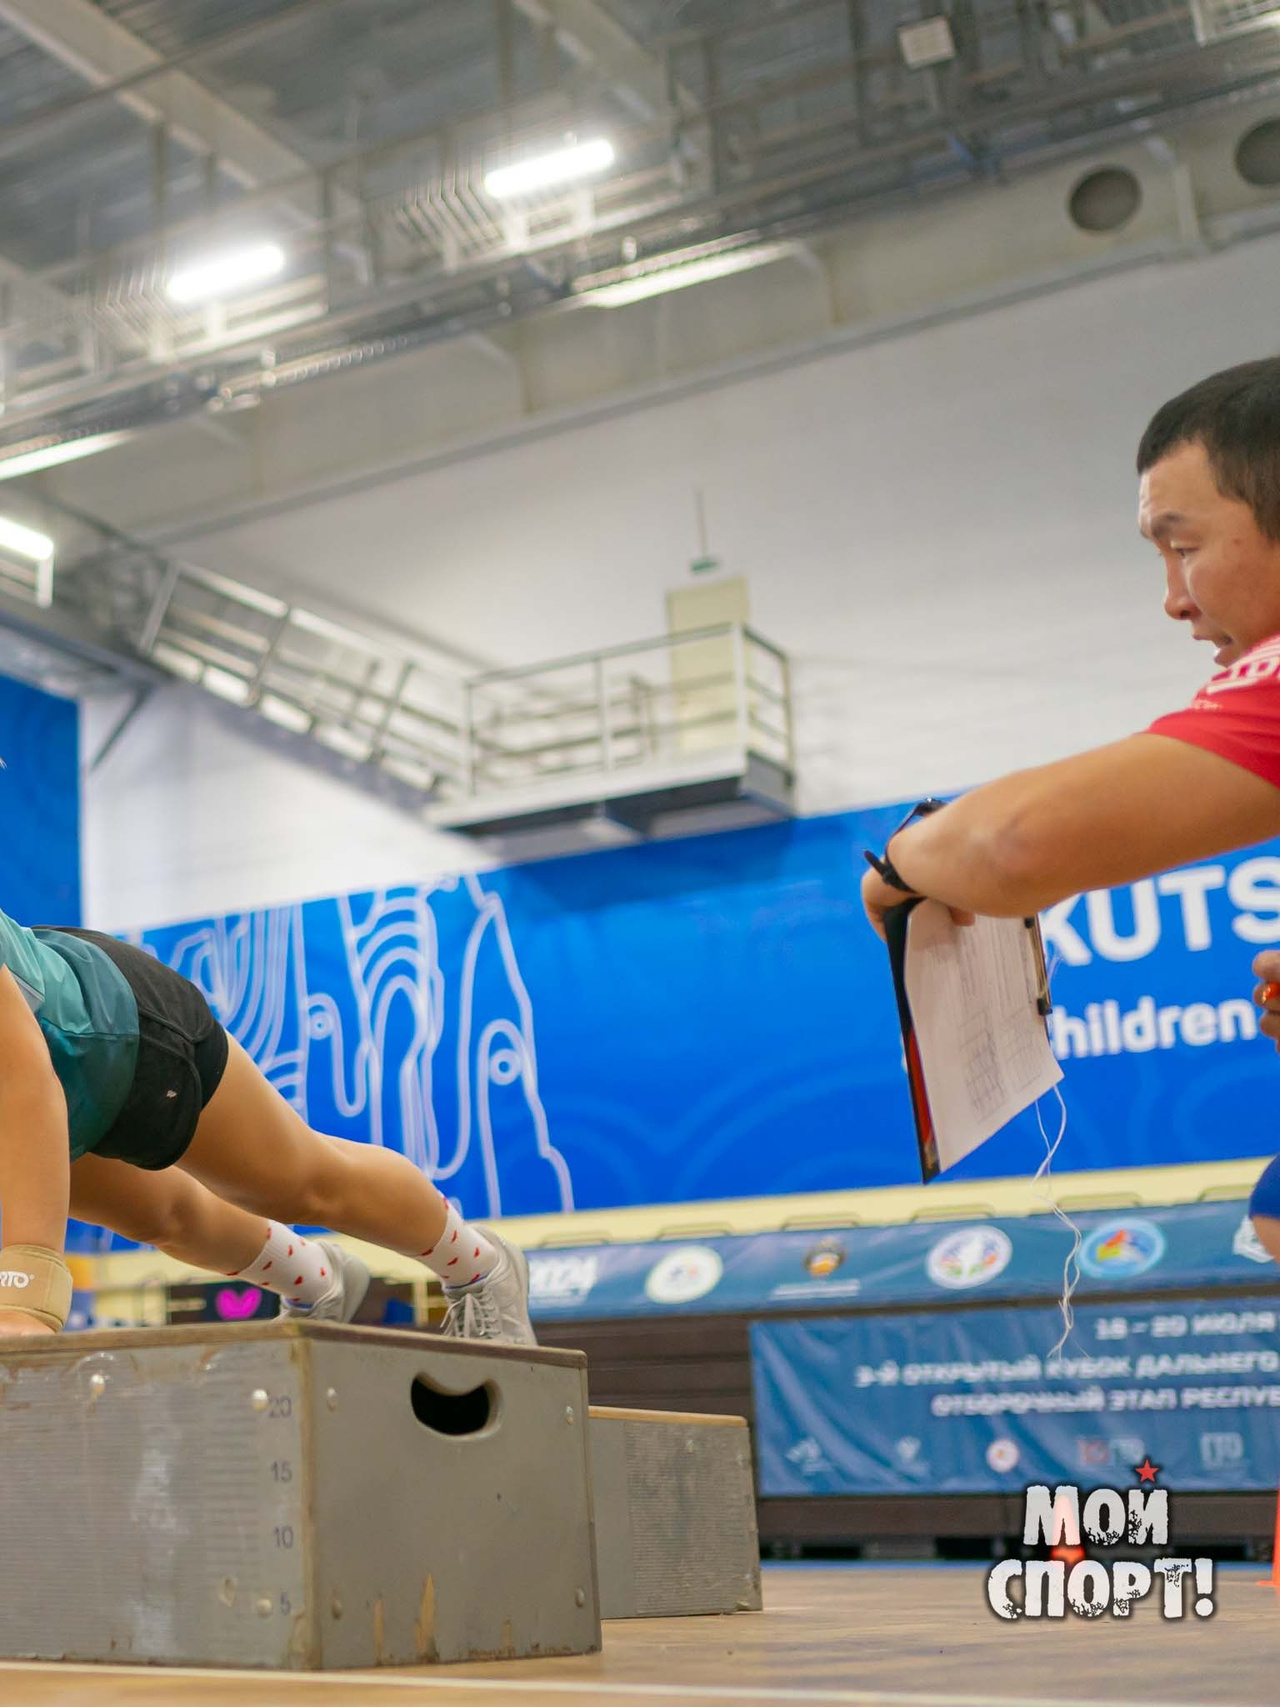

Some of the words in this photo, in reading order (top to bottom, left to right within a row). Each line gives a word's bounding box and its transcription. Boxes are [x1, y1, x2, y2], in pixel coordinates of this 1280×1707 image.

[1045, 995, 1258, 1061] hildren
[269, 1395, 292, 1419] 20
[271, 1460, 293, 1483] 15
[273, 1525, 294, 1549] 10
[279, 1591, 291, 1616] 5
